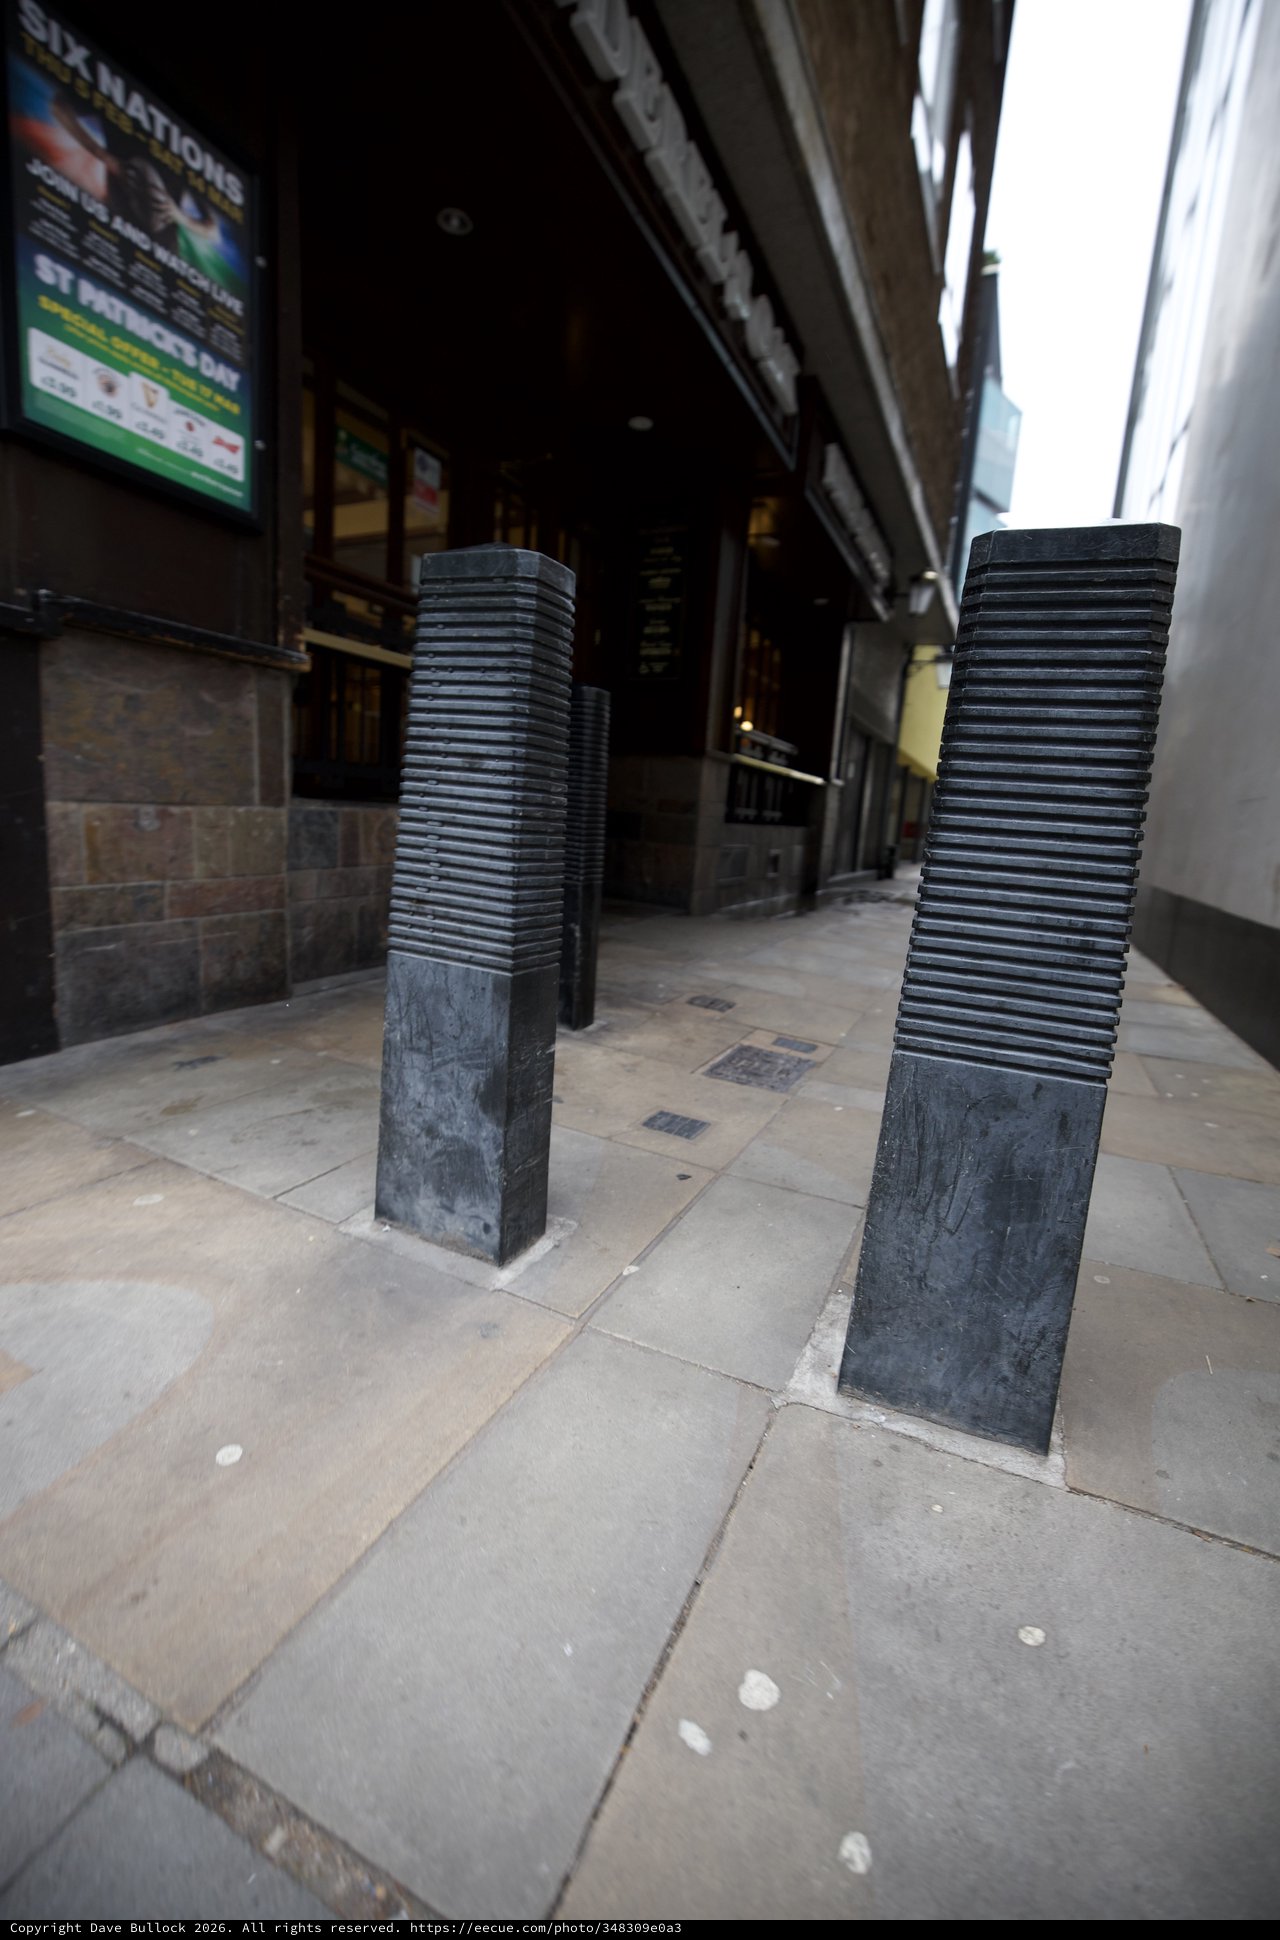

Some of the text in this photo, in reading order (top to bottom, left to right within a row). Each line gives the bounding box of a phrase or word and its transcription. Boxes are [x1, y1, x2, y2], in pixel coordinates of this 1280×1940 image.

[18, 0, 245, 206] SIX NATIONS
[20, 31, 72, 85] THU
[93, 90, 134, 136] FEB
[150, 137, 184, 176] SAT
[26, 158, 80, 203] JOIN
[81, 191, 110, 223] US
[111, 214, 152, 251] AND
[153, 243, 210, 296] WATCH
[211, 284, 245, 317] LIVE
[34, 253, 75, 295] ST
[78, 278, 198, 369] PATRICK'S
[200, 352, 242, 392] DAY
[38, 294, 108, 343] SPECIAL
[110, 334, 160, 370] OFFER
